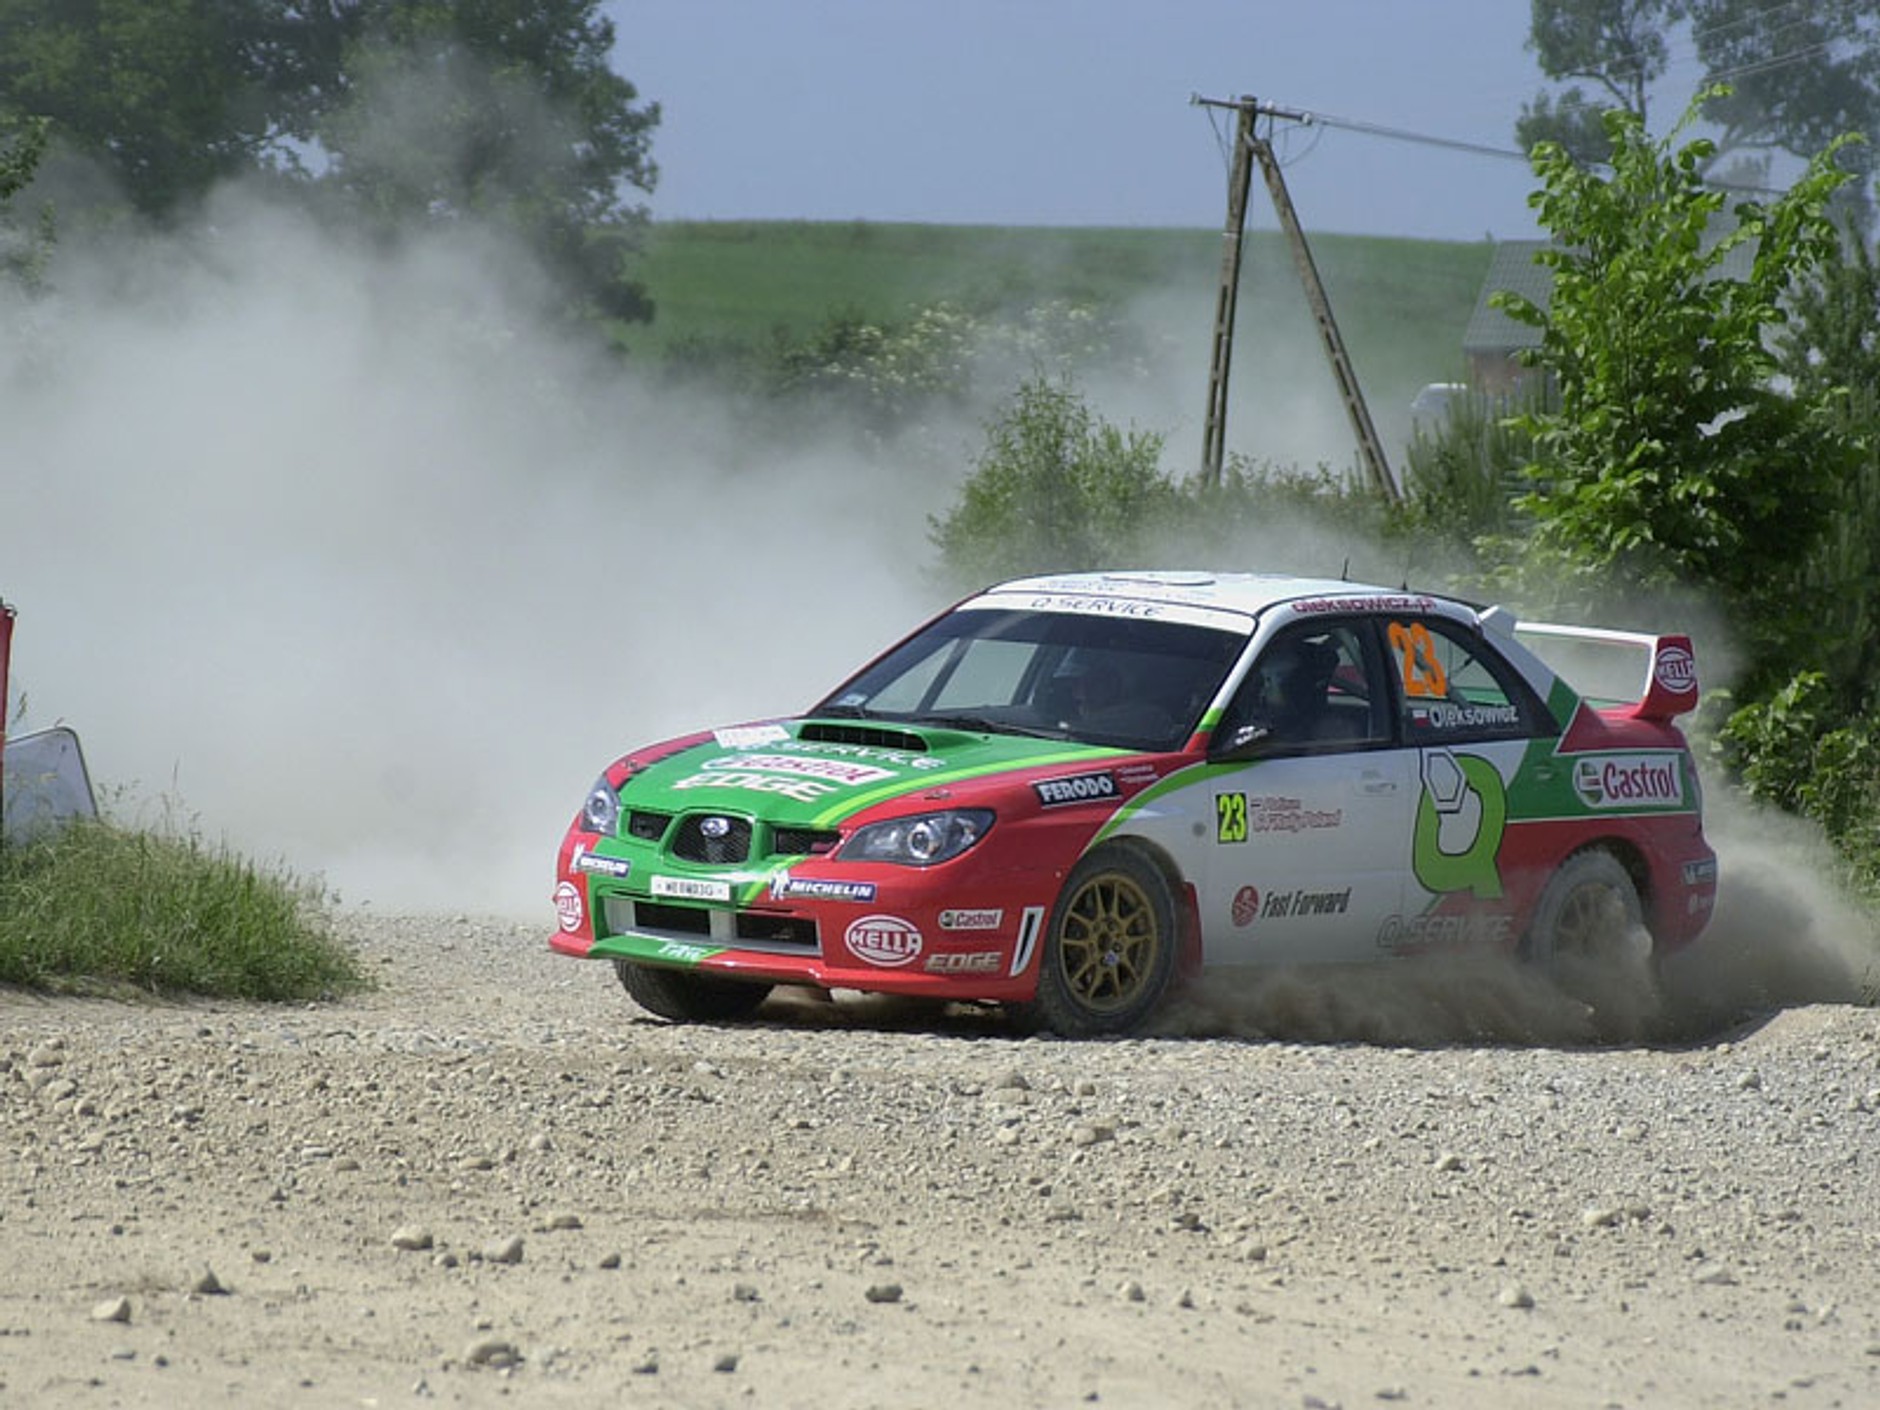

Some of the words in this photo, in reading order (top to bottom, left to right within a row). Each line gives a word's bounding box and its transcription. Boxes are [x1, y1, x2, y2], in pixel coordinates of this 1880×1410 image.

[1059, 598, 1164, 617] SERVICE
[1387, 621, 1448, 697] 23
[672, 771, 839, 803] EDGE
[1037, 775, 1114, 803] FERODO
[1603, 761, 1680, 800] Castrol
[1218, 793, 1246, 841] 23
[789, 881, 873, 898] MICHELIN
[1260, 891, 1293, 919] Fast
[1290, 887, 1353, 916] Forward
[956, 912, 998, 927] Castrol
[850, 928, 923, 956] HELLA
[925, 952, 1003, 972] EDGE
